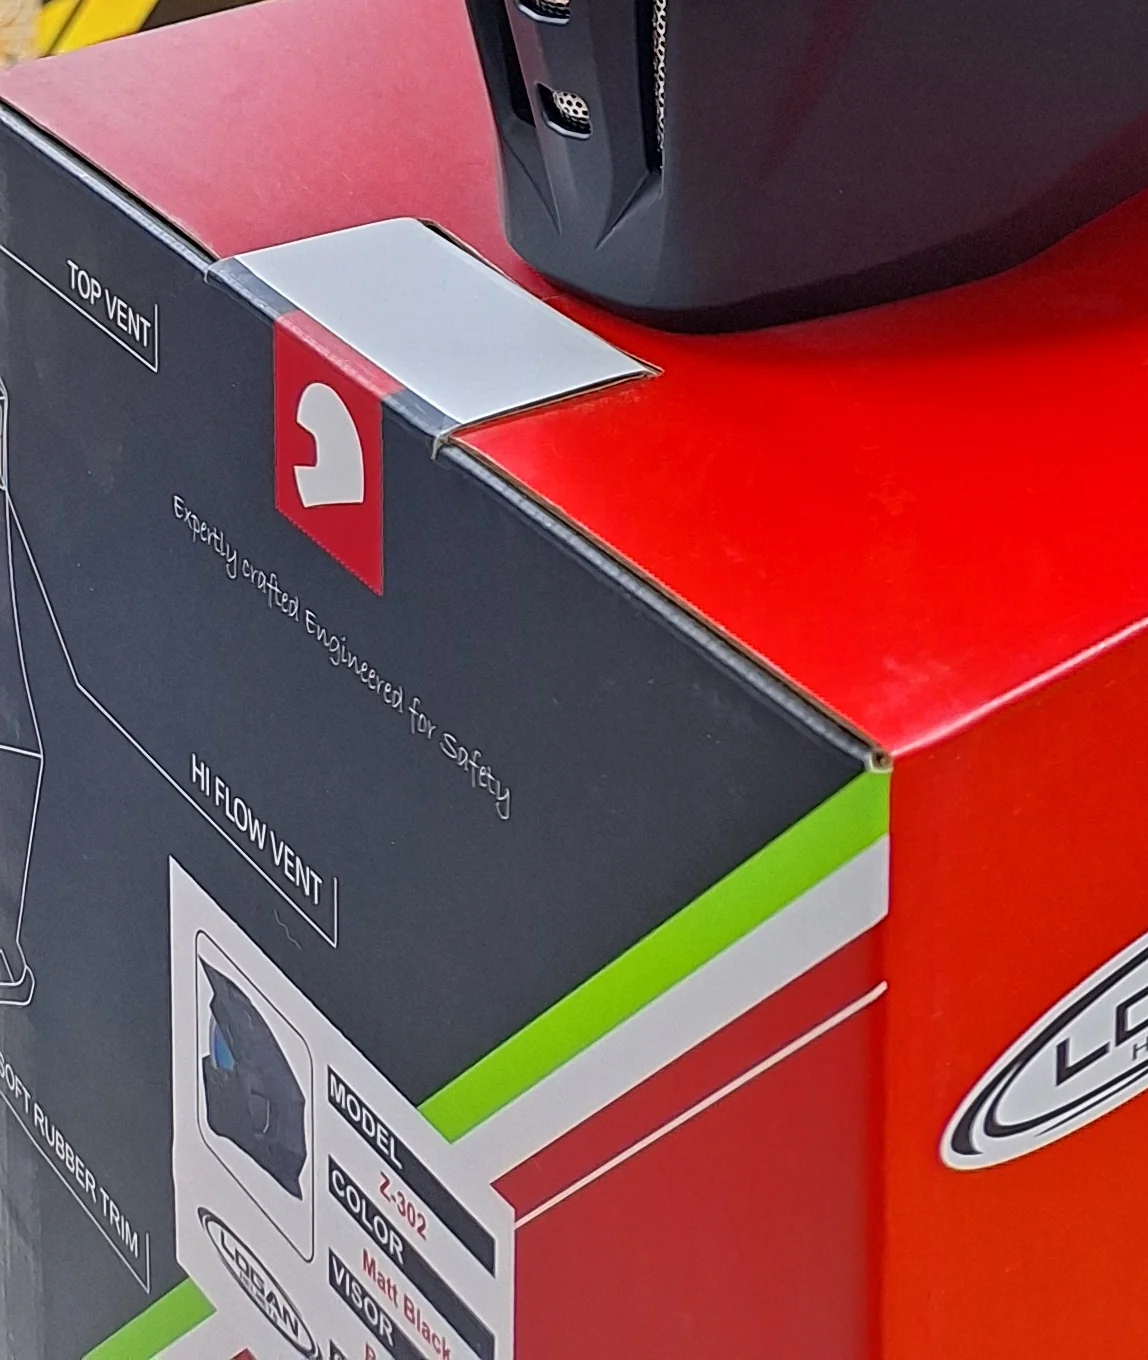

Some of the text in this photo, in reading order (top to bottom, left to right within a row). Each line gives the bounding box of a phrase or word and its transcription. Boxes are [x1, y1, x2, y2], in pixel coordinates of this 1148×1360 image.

[67, 259, 151, 347] TOP VENT
[173, 495, 510, 819] Expertly crafted Engineered for Safety
[192, 753, 322, 904] HI FLOW VENT
[330, 1073, 403, 1170] MODEL
[34, 1102, 96, 1203] RUBBER
[100, 1187, 138, 1257] TRIM
[332, 1169, 404, 1265] COLOR
[380, 1171, 427, 1241] Z-302
[220, 1231, 299, 1337] LOGAN
[332, 1256, 394, 1348] VISOR
[363, 1247, 451, 1360] Matt Black
